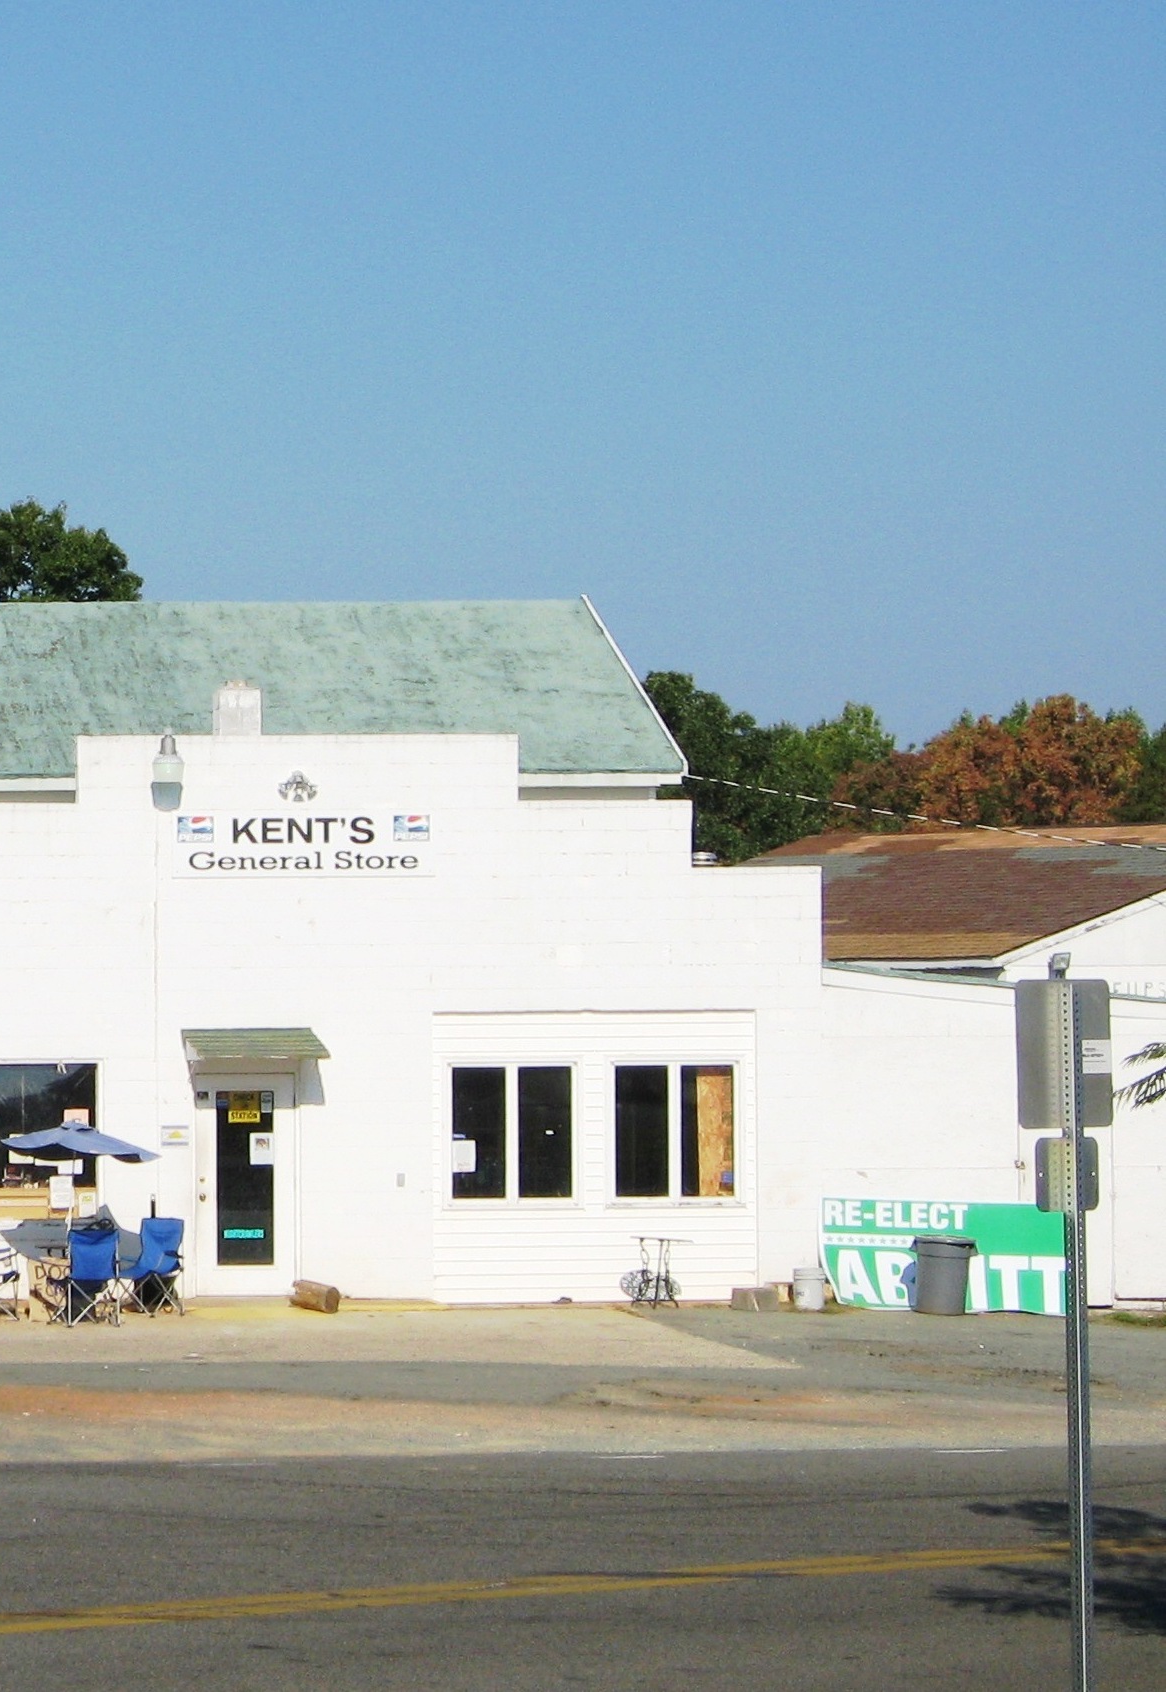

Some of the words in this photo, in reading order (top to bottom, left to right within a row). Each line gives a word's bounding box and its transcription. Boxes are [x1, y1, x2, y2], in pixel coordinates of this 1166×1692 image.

[232, 816, 375, 844] KENT'S
[188, 851, 323, 870] General
[334, 850, 419, 870] Store
[824, 1200, 969, 1230] RE-ELECT
[837, 1250, 1067, 1315] ABITT
